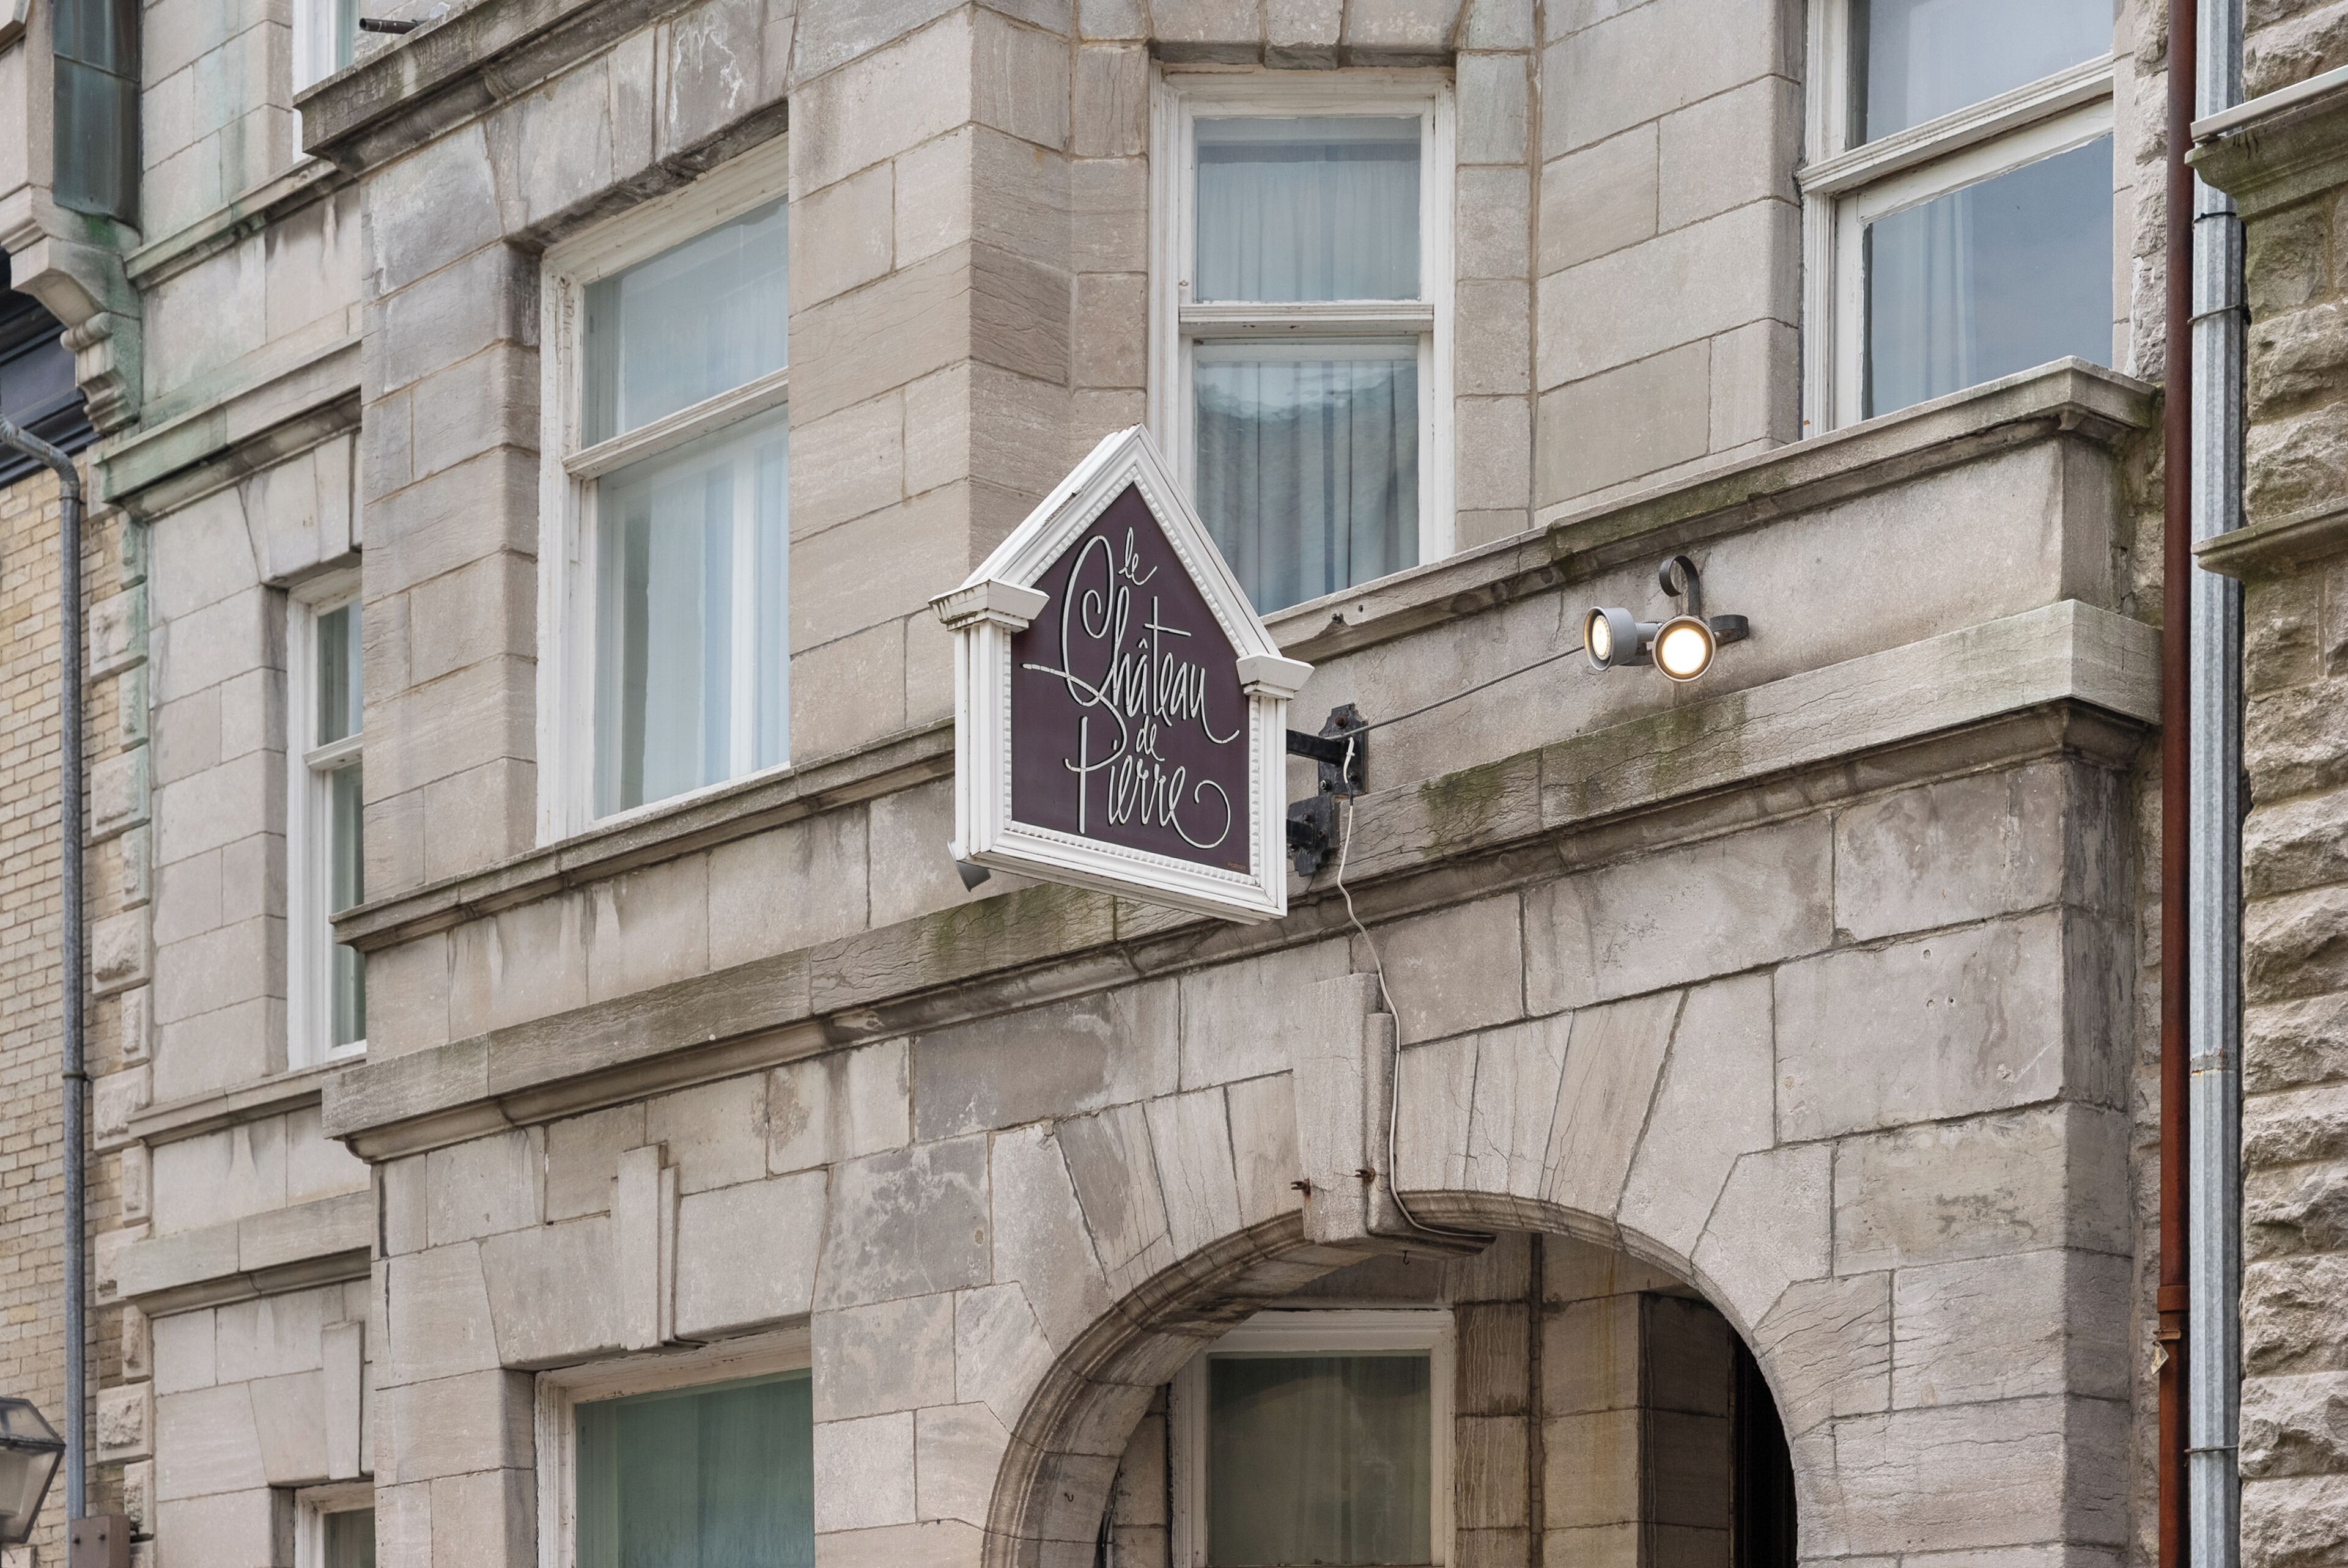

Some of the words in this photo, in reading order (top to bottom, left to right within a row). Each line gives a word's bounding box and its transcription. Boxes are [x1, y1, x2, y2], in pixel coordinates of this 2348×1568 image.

[1118, 526, 1157, 586] le
[1060, 534, 1239, 744] Château
[1022, 663, 1231, 850] Pierre
[1135, 715, 1165, 762] de
